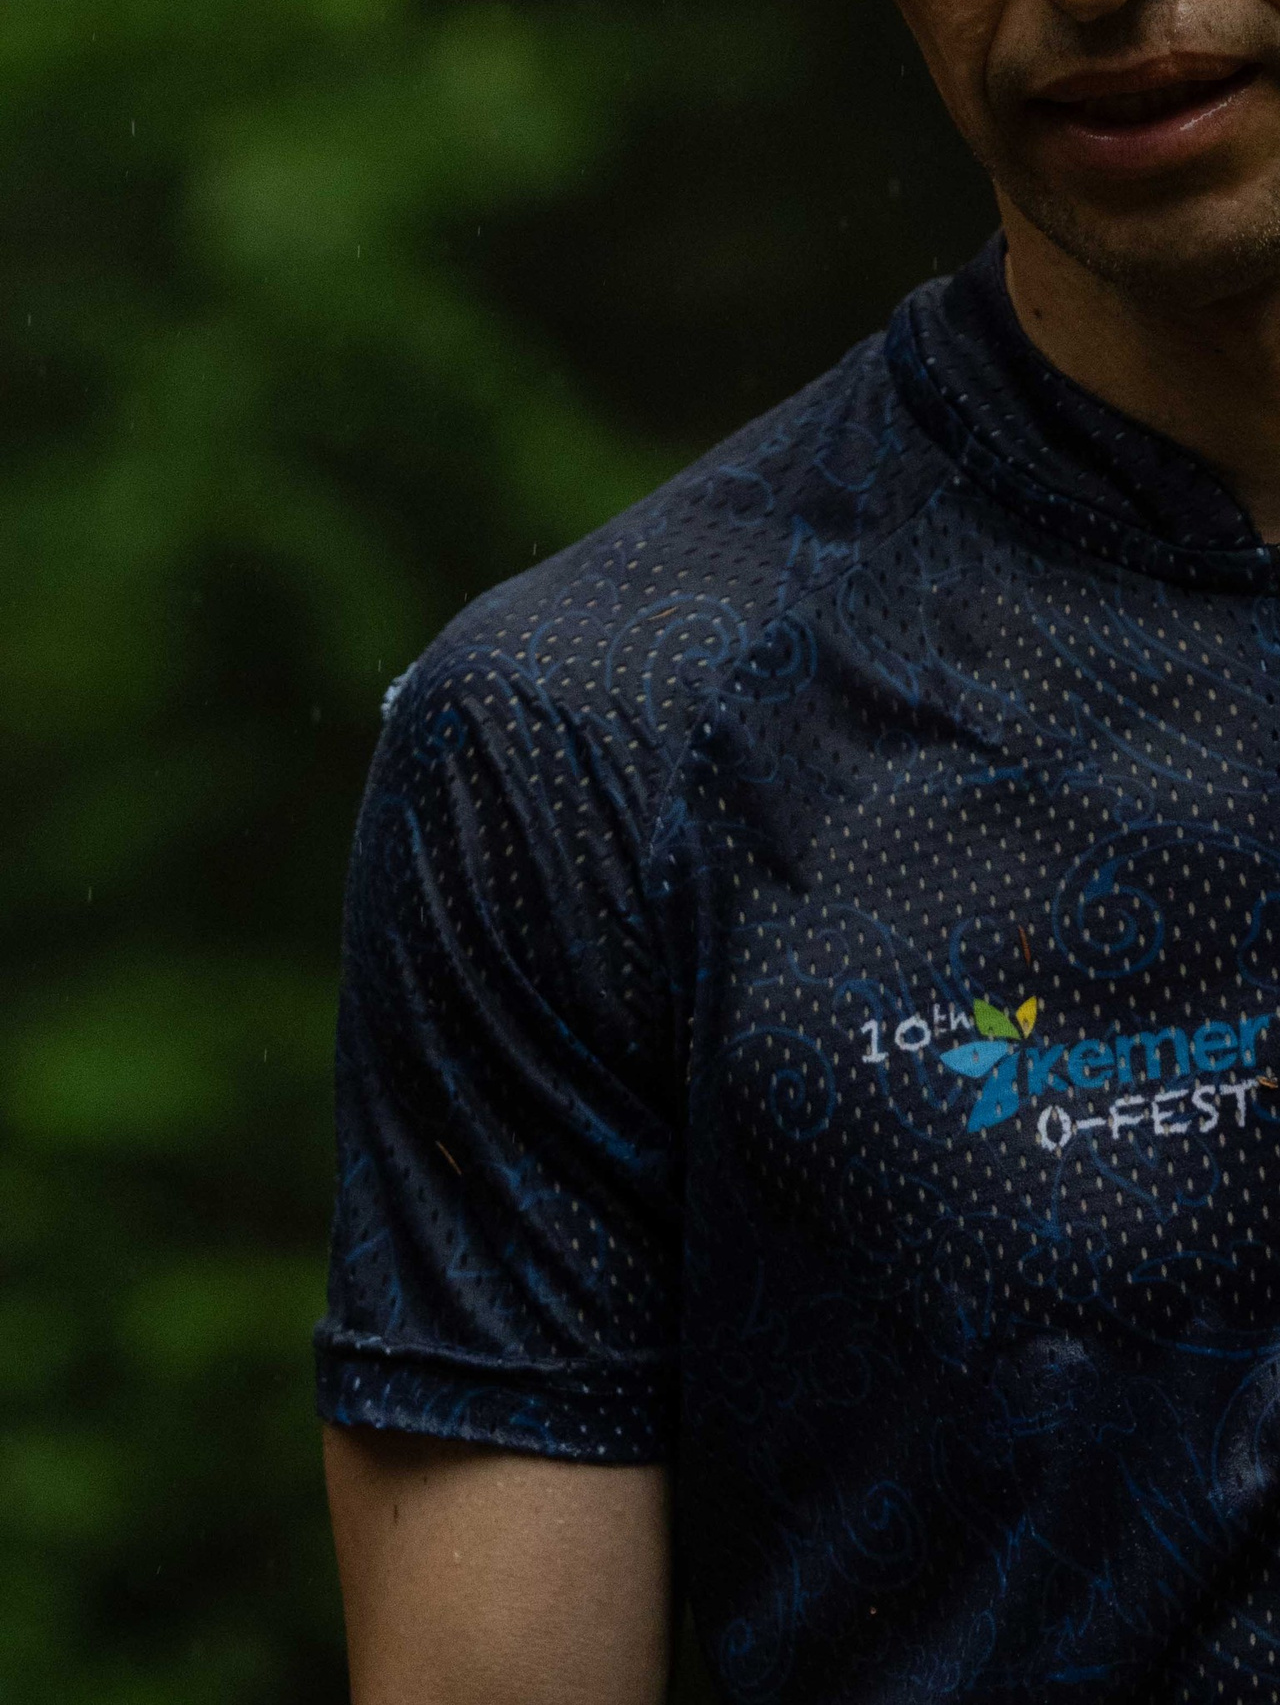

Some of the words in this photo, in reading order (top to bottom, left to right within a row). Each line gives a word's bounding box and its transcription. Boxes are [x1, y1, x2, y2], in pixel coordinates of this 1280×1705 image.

[860, 1002, 971, 1064] 10th
[1027, 1013, 1271, 1096] kemer
[1036, 1078, 1260, 1152] O-FEST
